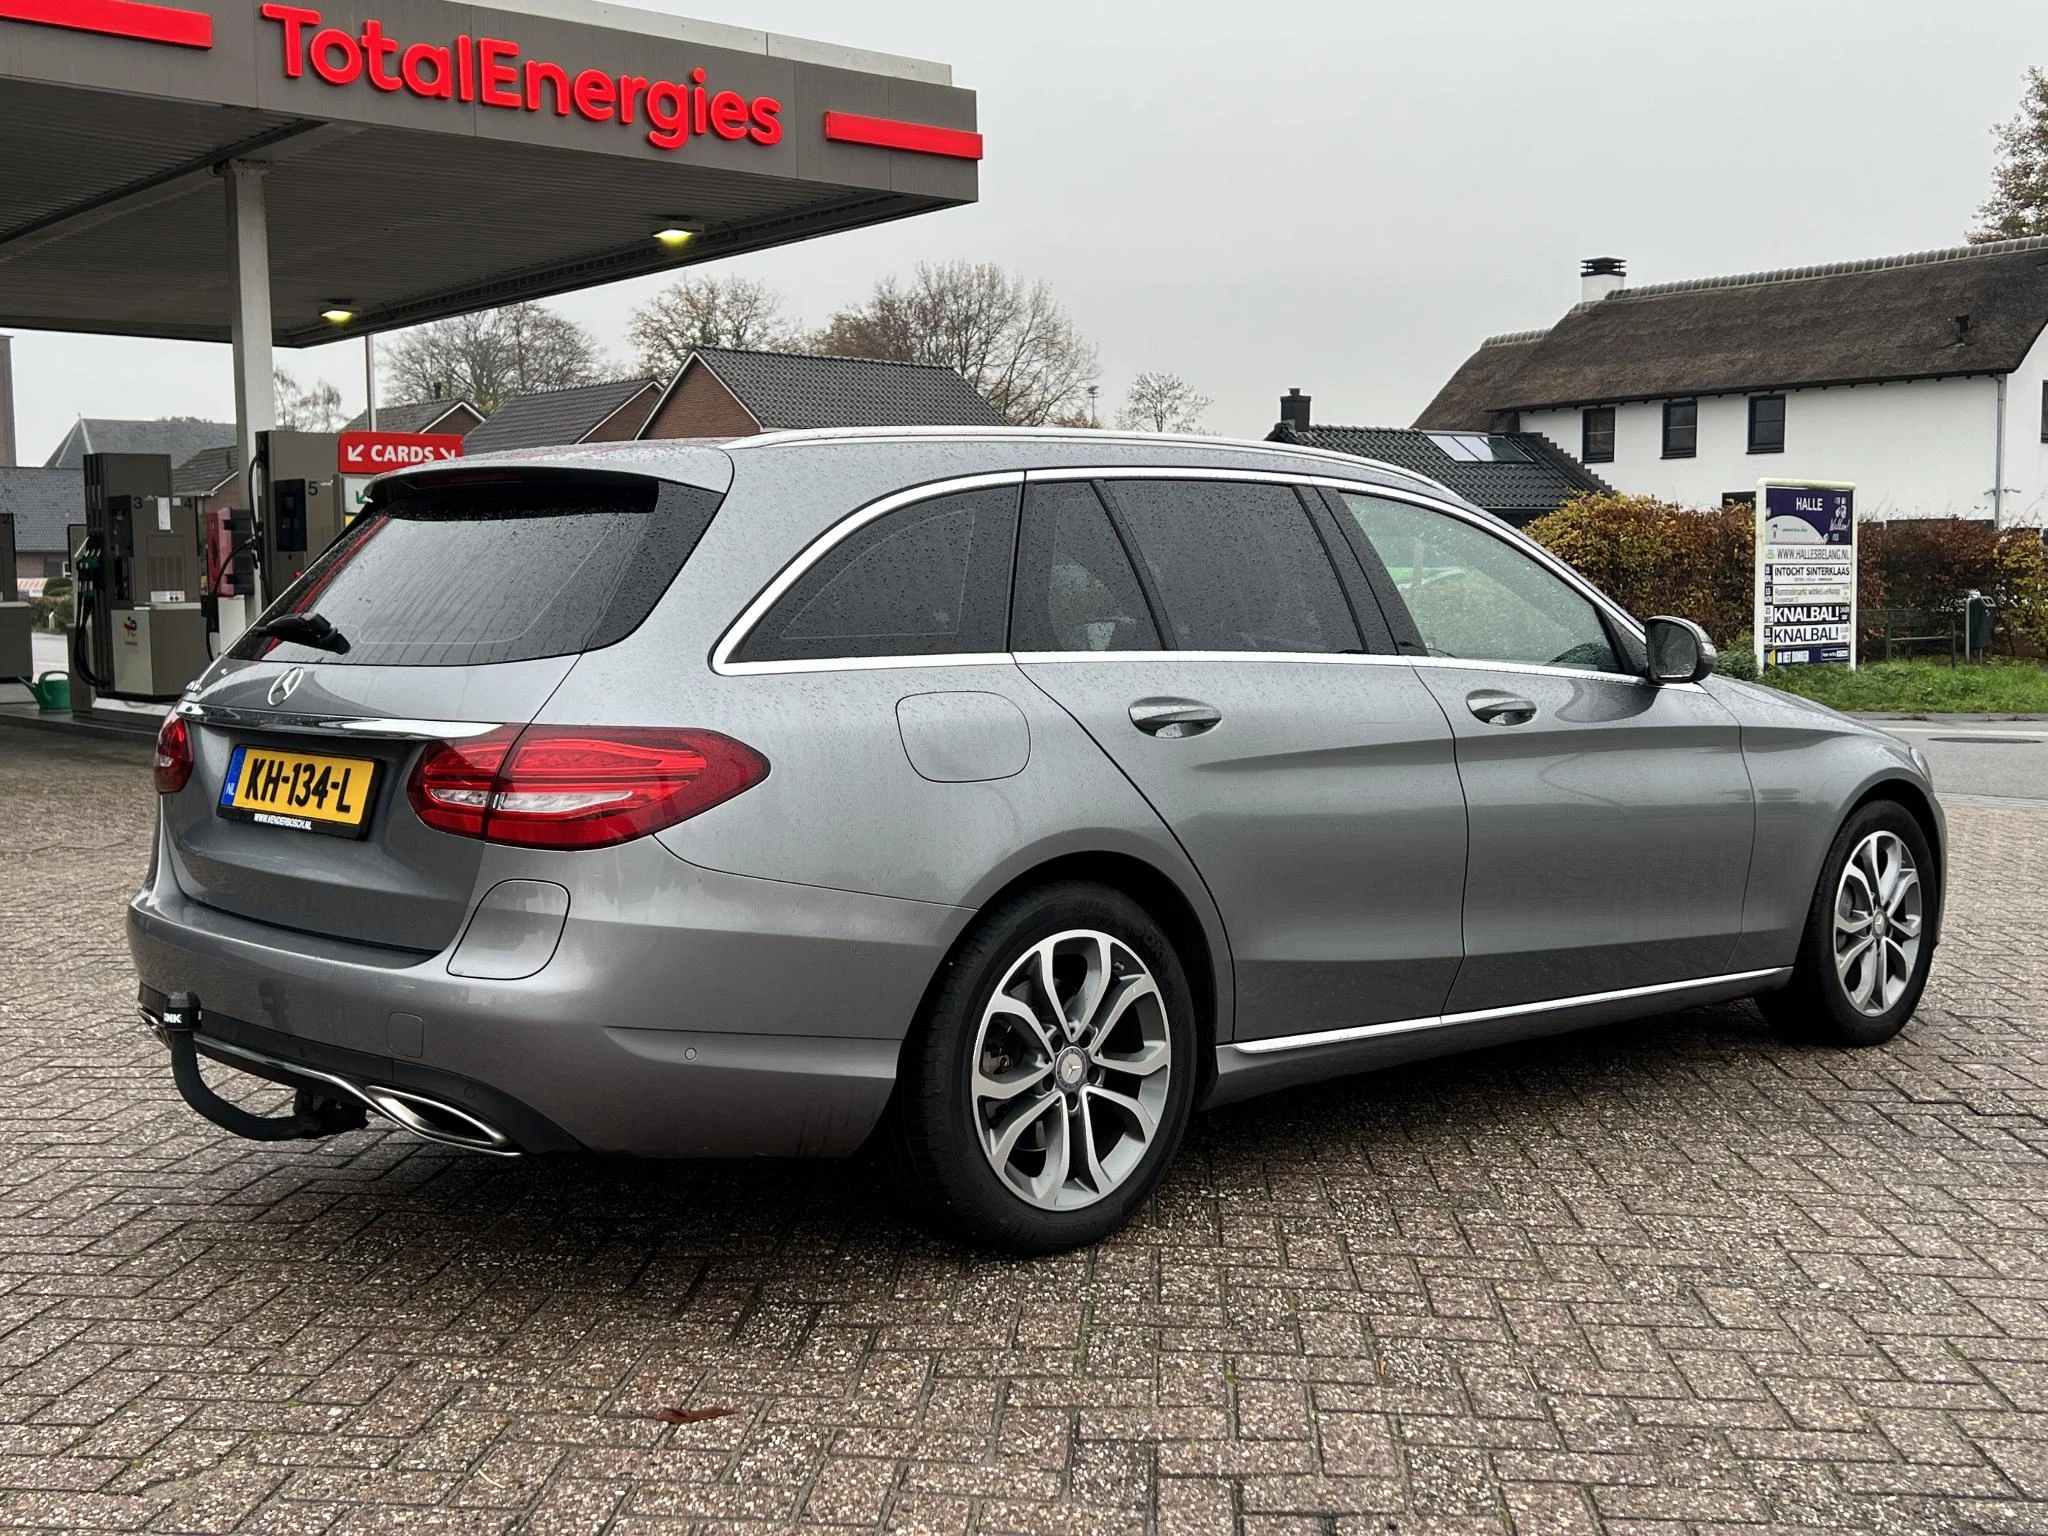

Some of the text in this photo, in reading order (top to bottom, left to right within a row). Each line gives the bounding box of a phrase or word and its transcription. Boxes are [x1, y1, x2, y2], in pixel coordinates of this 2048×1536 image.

[260, 3, 783, 150] TotalEnergies
[371, 445, 435, 462] CARDS
[307, 481, 318, 496] 5
[134, 497, 143, 509] 3
[183, 498, 192, 509] 4
[1796, 497, 1823, 511] HALLE
[1777, 548, 1850, 560] WWW.HALLESBELANG.NL
[1775, 567, 1804, 576] INTOCHT
[1806, 566, 1850, 576] SINTERKLAAS
[1774, 606, 1839, 623] KNALBAL!
[1774, 627, 1839, 643] KNALBAL!
[226, 782, 234, 795] NL
[244, 758, 352, 813] KH-134-L
